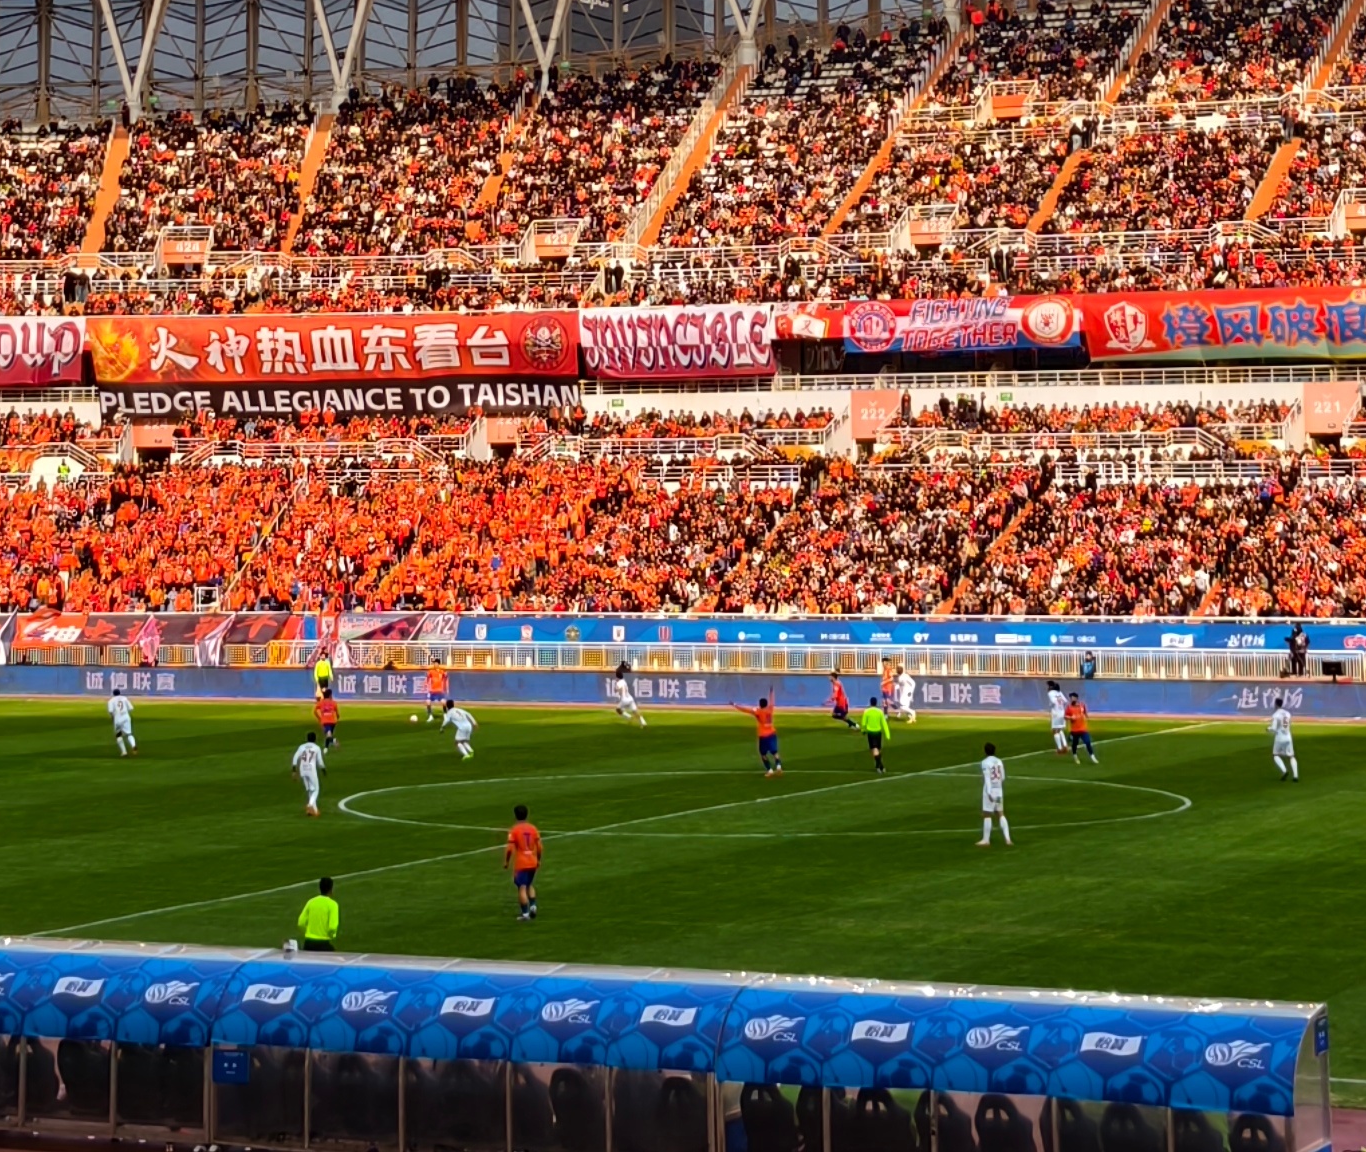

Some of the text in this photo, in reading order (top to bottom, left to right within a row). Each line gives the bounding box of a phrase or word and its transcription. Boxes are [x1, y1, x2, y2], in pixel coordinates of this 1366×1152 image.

[149, 322, 511, 376] 火神热血东看台
[100, 382, 580, 414] PLEDGE ALLEGIANCE TO TAISHAN
[1314, 401, 1341, 413] 221
[861, 408, 885, 420] 222
[897, 682, 1002, 705] 信联赛
[300, 750, 316, 764] 47
[169, 996, 190, 1006] CSL
[367, 1005, 388, 1015] CSL
[569, 1014, 592, 1024] CSL
[773, 1032, 797, 1043] CSL
[996, 1041, 1022, 1052] CSL
[1237, 1058, 1265, 1069] CSL
